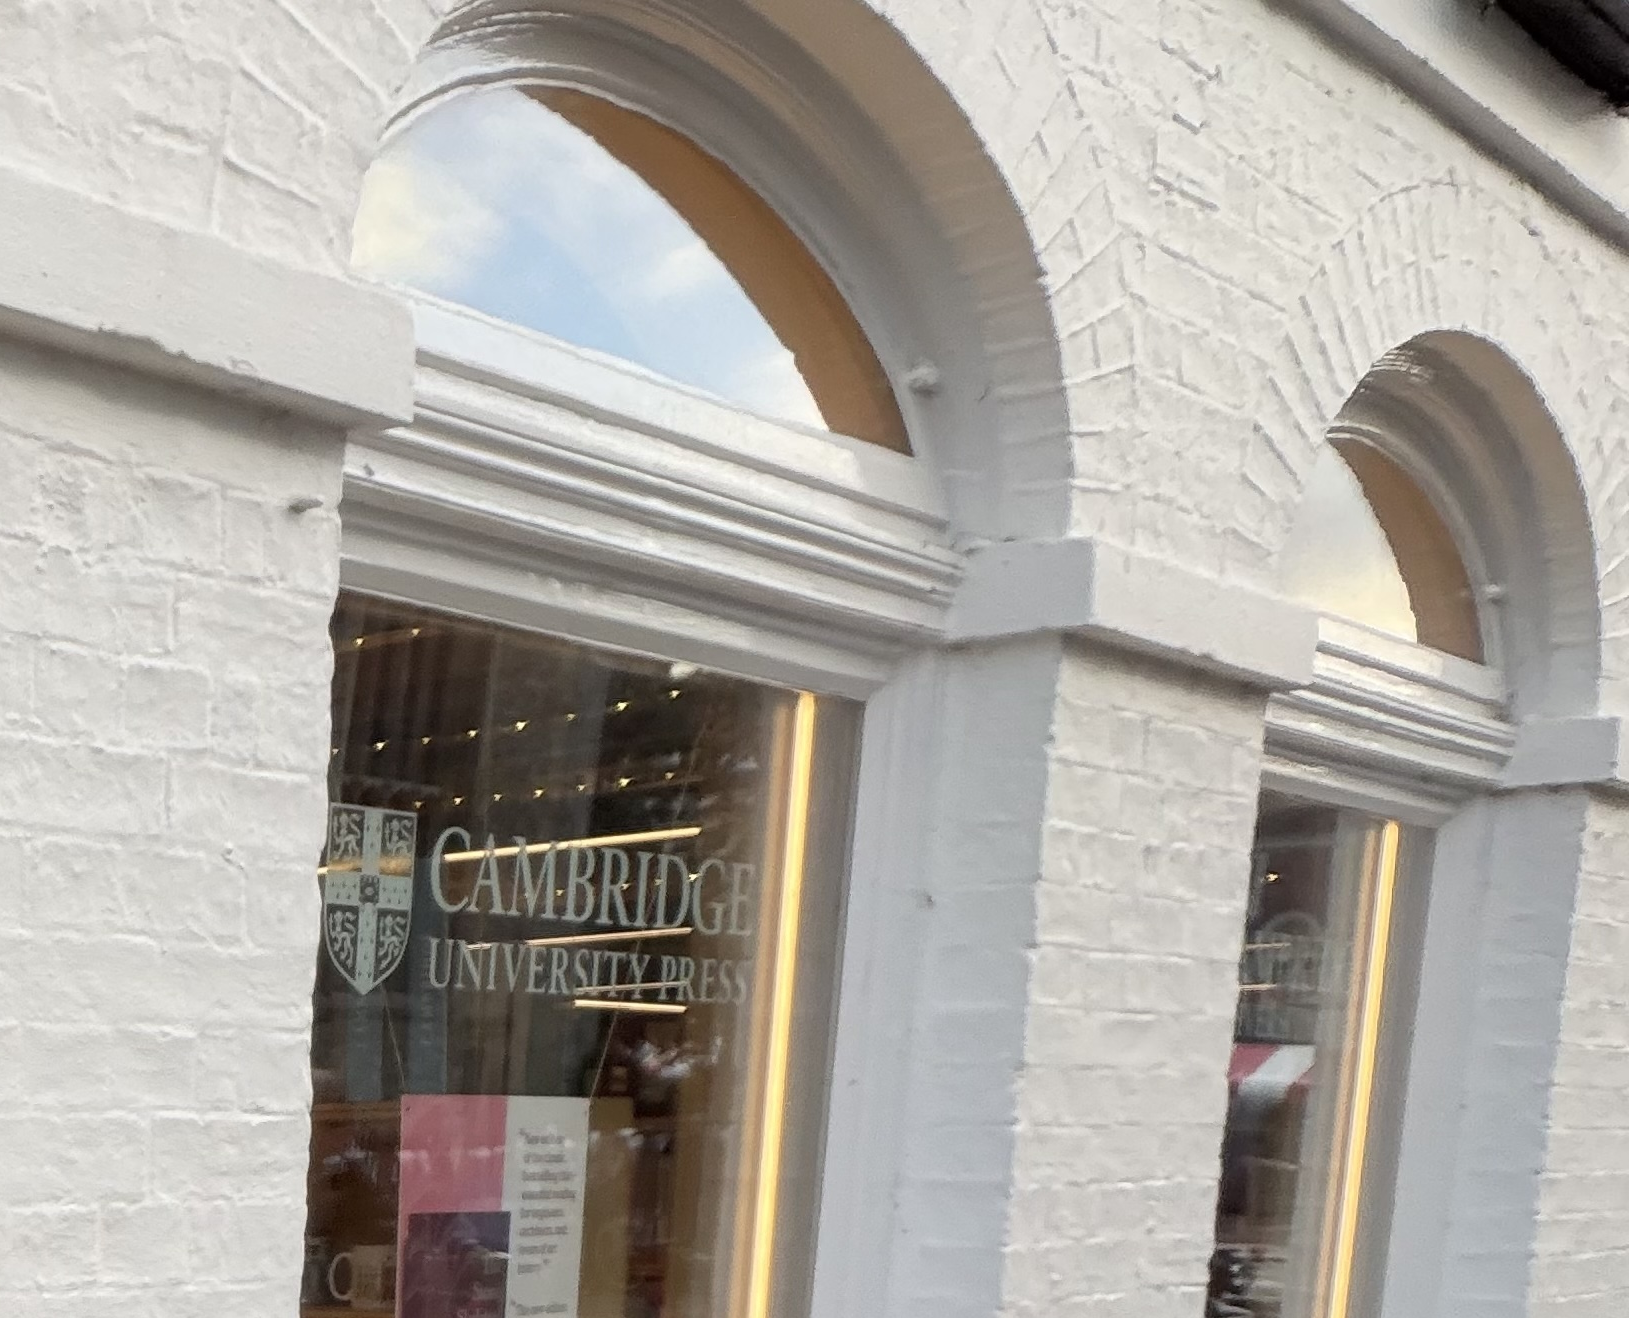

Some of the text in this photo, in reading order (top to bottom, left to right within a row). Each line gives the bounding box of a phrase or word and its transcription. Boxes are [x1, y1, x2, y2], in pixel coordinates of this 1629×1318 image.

[430, 827, 756, 938] CAMBRIDGE
[428, 938, 750, 1004] UNIVERSITY PRESS
